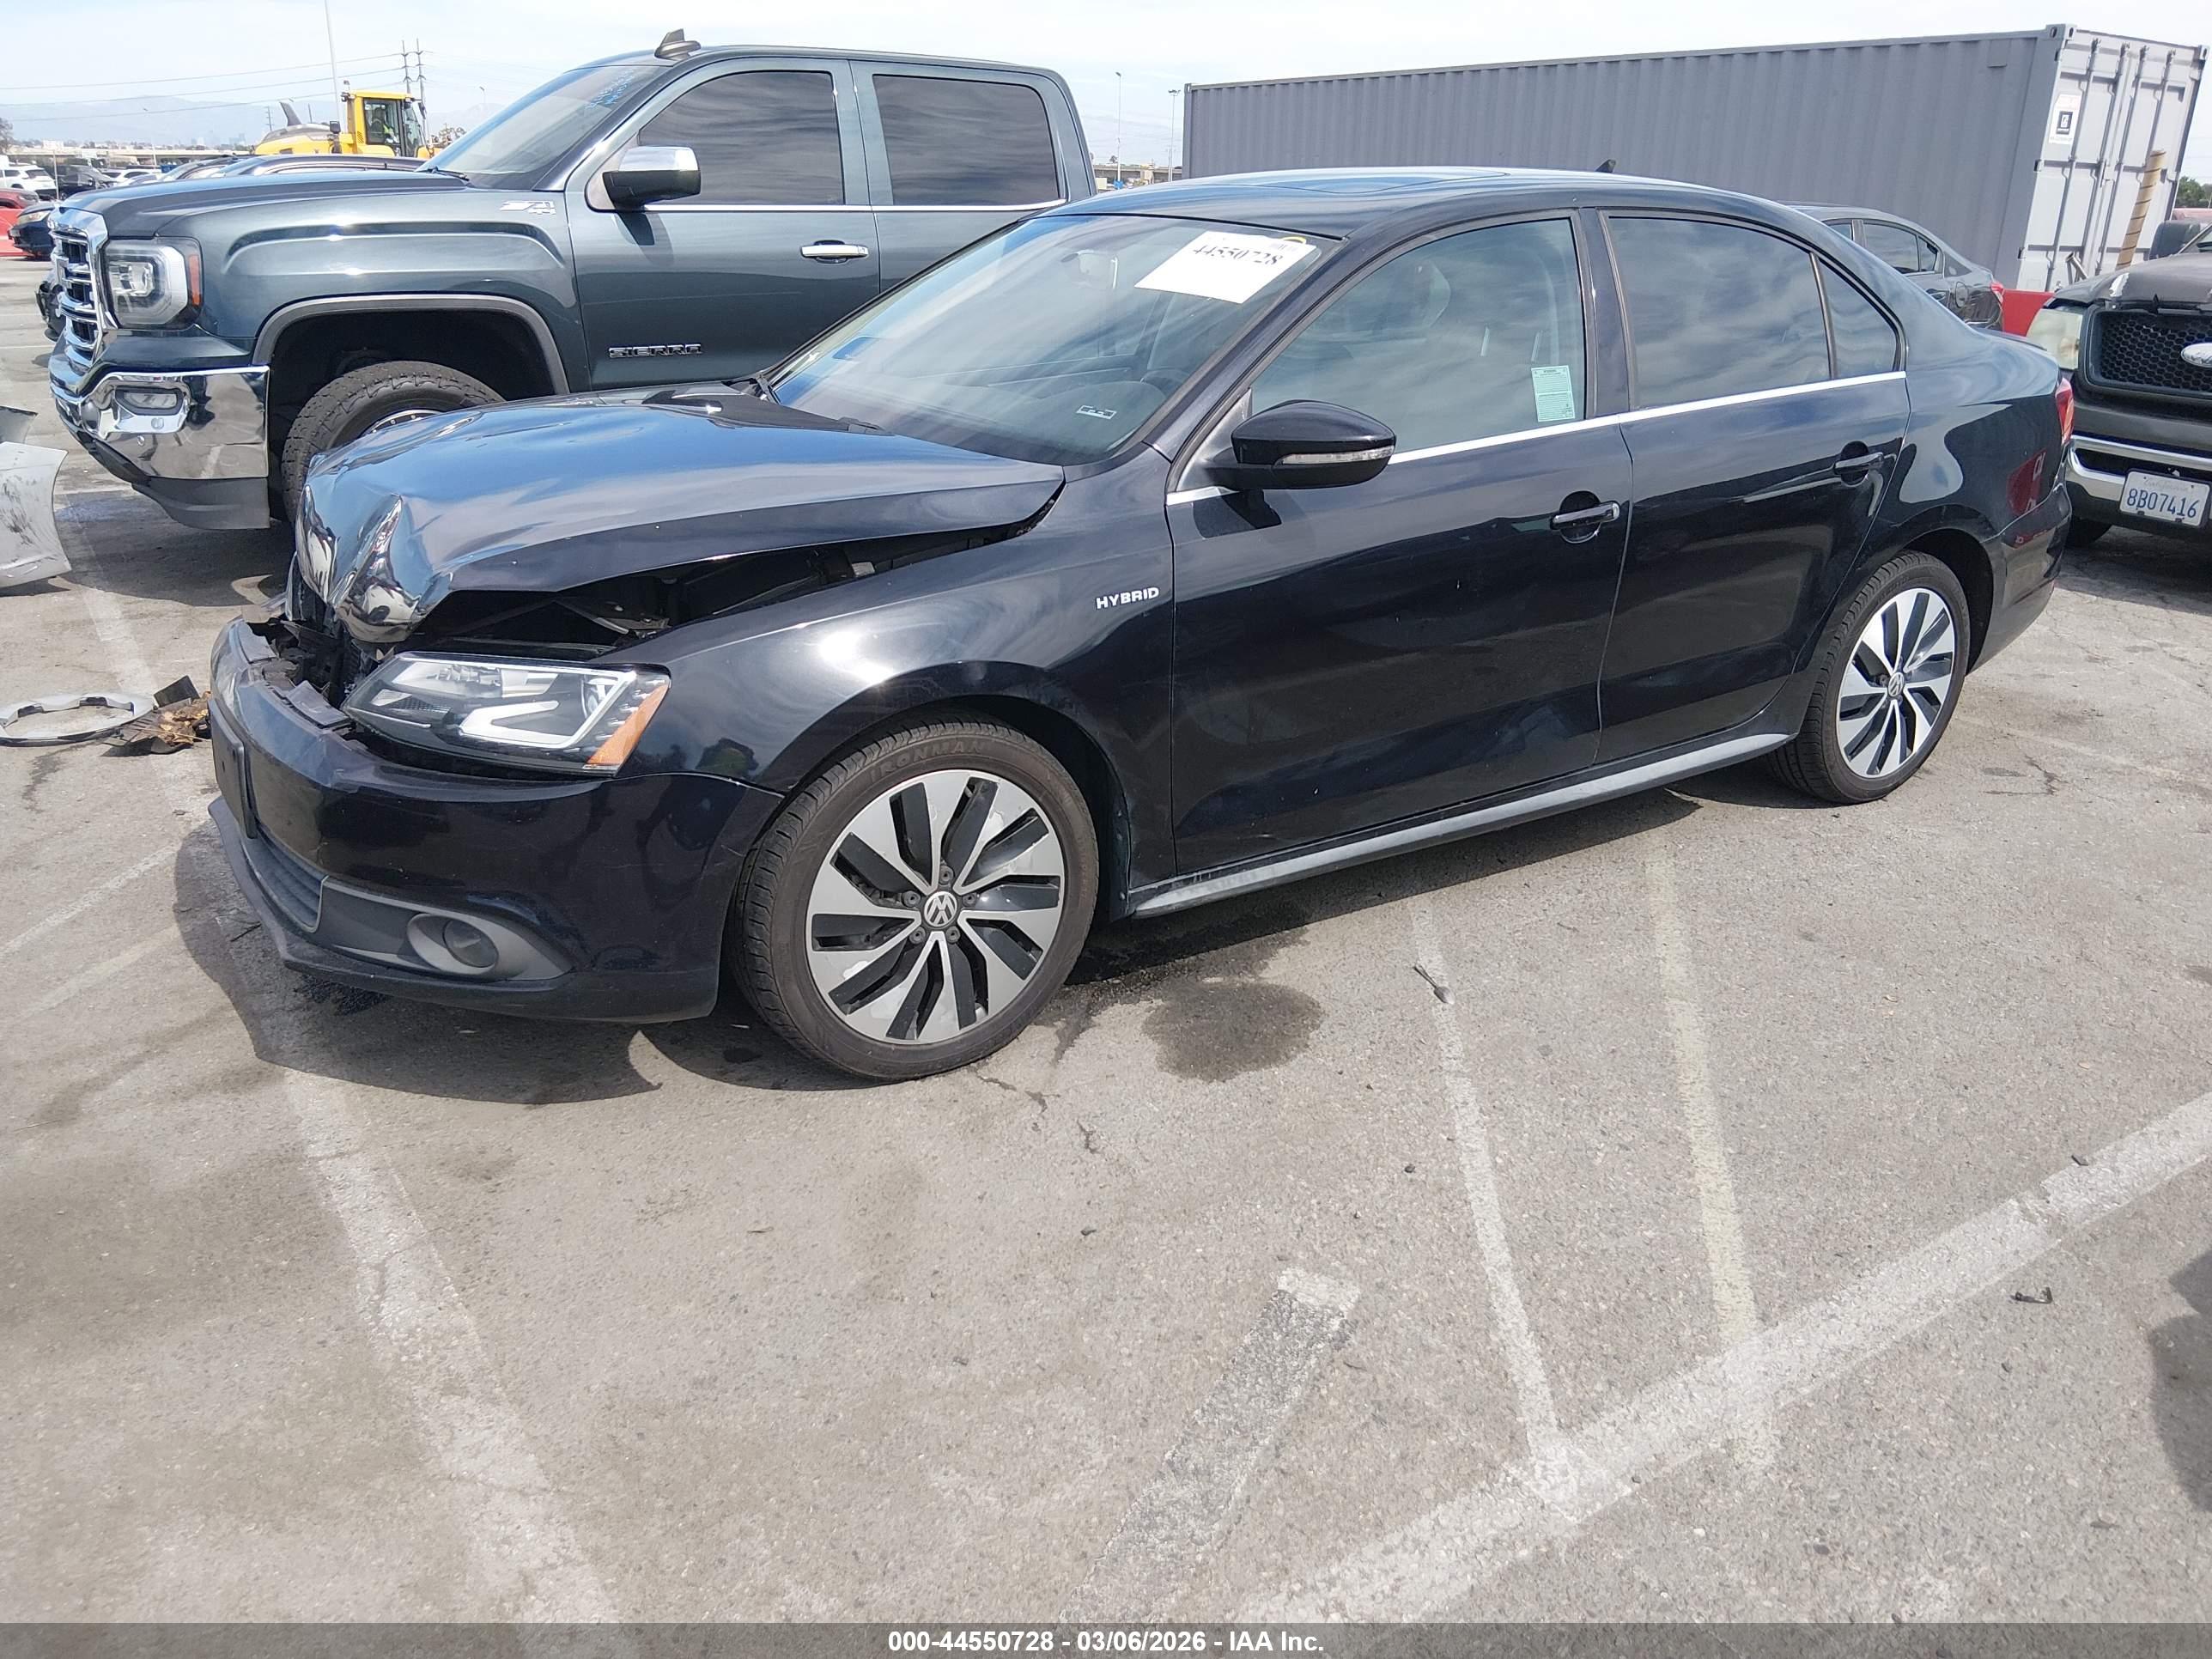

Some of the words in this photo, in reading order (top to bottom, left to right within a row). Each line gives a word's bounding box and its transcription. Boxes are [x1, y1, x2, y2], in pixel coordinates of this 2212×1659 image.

[1193, 244, 1284, 265] 44550728
[609, 343, 702, 358] SIERRA
[2127, 488, 2200, 519] 8B07416
[1096, 586, 1160, 610] HYBRID
